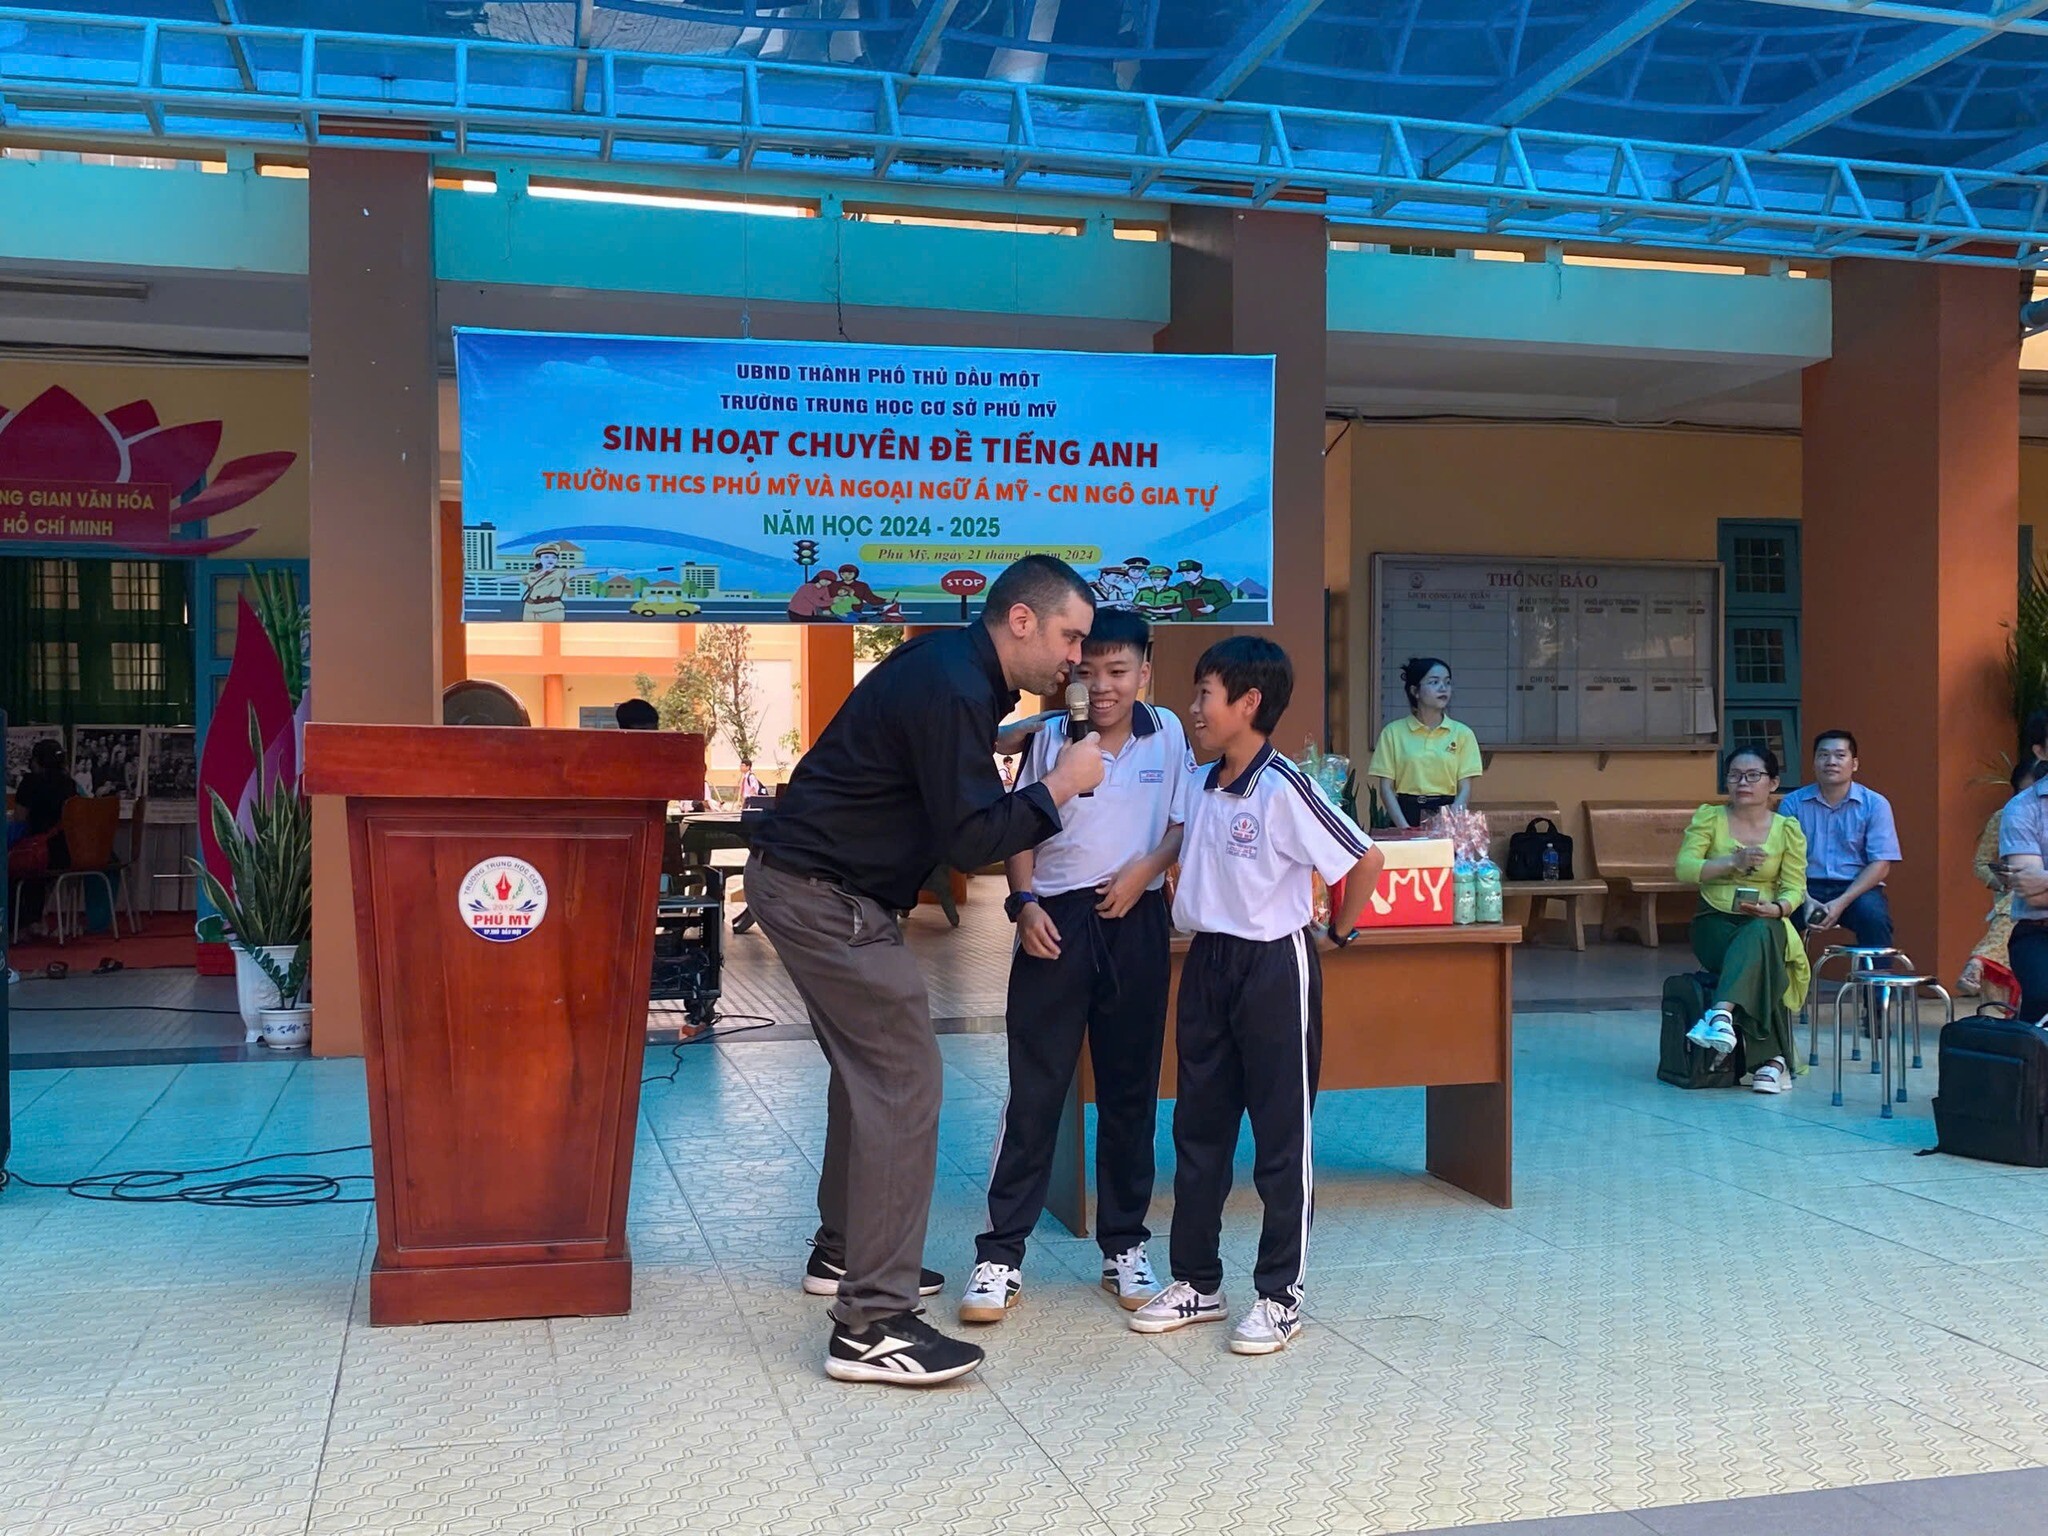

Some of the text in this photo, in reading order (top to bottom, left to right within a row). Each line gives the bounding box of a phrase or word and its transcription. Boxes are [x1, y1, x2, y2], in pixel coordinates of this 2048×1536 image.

[737, 364, 1040, 390] UBND THÀNH PHỐ THỦ DẦU MỘT
[720, 393, 1057, 417] TRƯỜNG TRUNG HỌC CƠ SỞ PHÚ MỸ
[602, 424, 1158, 468] SINH HOẠT CHUYÊN ĐỀ TIẾNG ANH
[28, 491, 72, 507] GIAN
[77, 489, 112, 509] VĂN
[117, 489, 154, 510] HÓA
[542, 467, 641, 492] TRƯỜNG
[646, 474, 706, 494] THCS
[713, 471, 761, 495] PHÚ
[768, 473, 800, 496] MỸ
[805, 473, 834, 497] VÀ
[840, 479, 912, 504] NGOẠI
[919, 477, 971, 500] NGỮ
[974, 477, 990, 500] Á
[996, 478, 1029, 502] MỸ
[1048, 484, 1078, 503] CN
[1085, 481, 1135, 505] NGÔ
[1141, 486, 1180, 505] GIA
[1185, 485, 1219, 512] TỰ
[34, 515, 66, 535] CHÍ
[70, 519, 113, 536] MINH
[763, 509, 814, 535] NĂM
[822, 515, 873, 542] HỌC
[880, 516, 931, 537] 2024
[950, 517, 1000, 537] 2025
[934, 551, 964, 562] ngày
[968, 550, 981, 560] 21
[985, 549, 1021, 561] tháng
[1065, 549, 1093, 560] 2024
[946, 578, 984, 588] STOP
[1486, 570, 1598, 588] THÔNG BÁO
[473, 912, 504, 925] PHÚ
